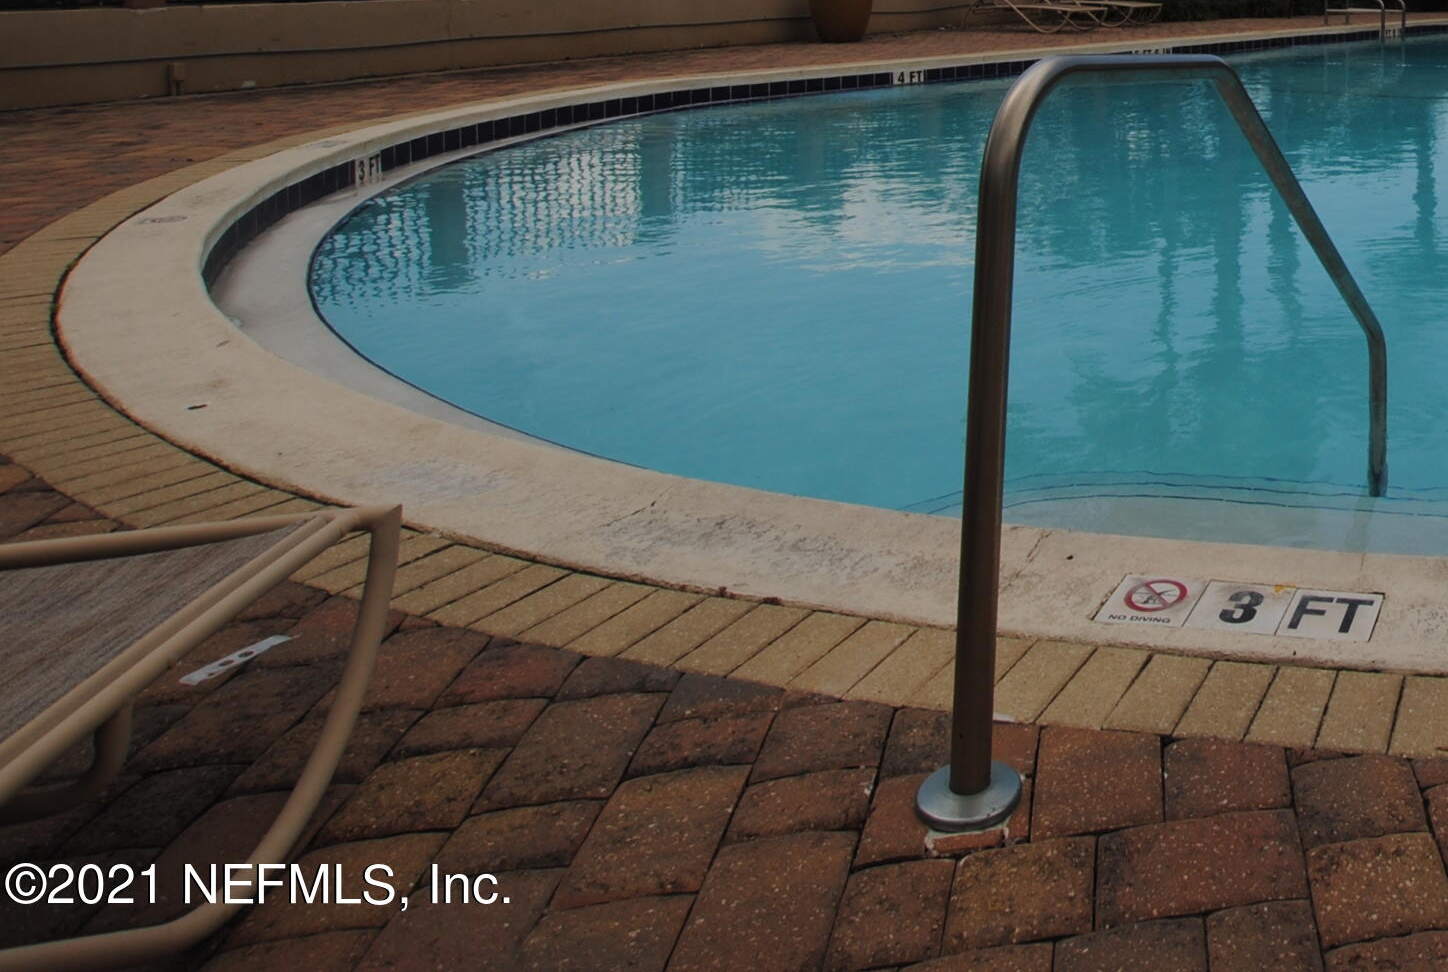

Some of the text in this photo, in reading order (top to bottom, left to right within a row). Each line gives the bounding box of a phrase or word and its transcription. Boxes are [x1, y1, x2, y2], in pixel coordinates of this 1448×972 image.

[897, 70, 923, 84] 4 FT
[357, 153, 380, 181] 3 FT
[1129, 615, 1171, 623] DIVING
[1218, 590, 1374, 634] 3 FT
